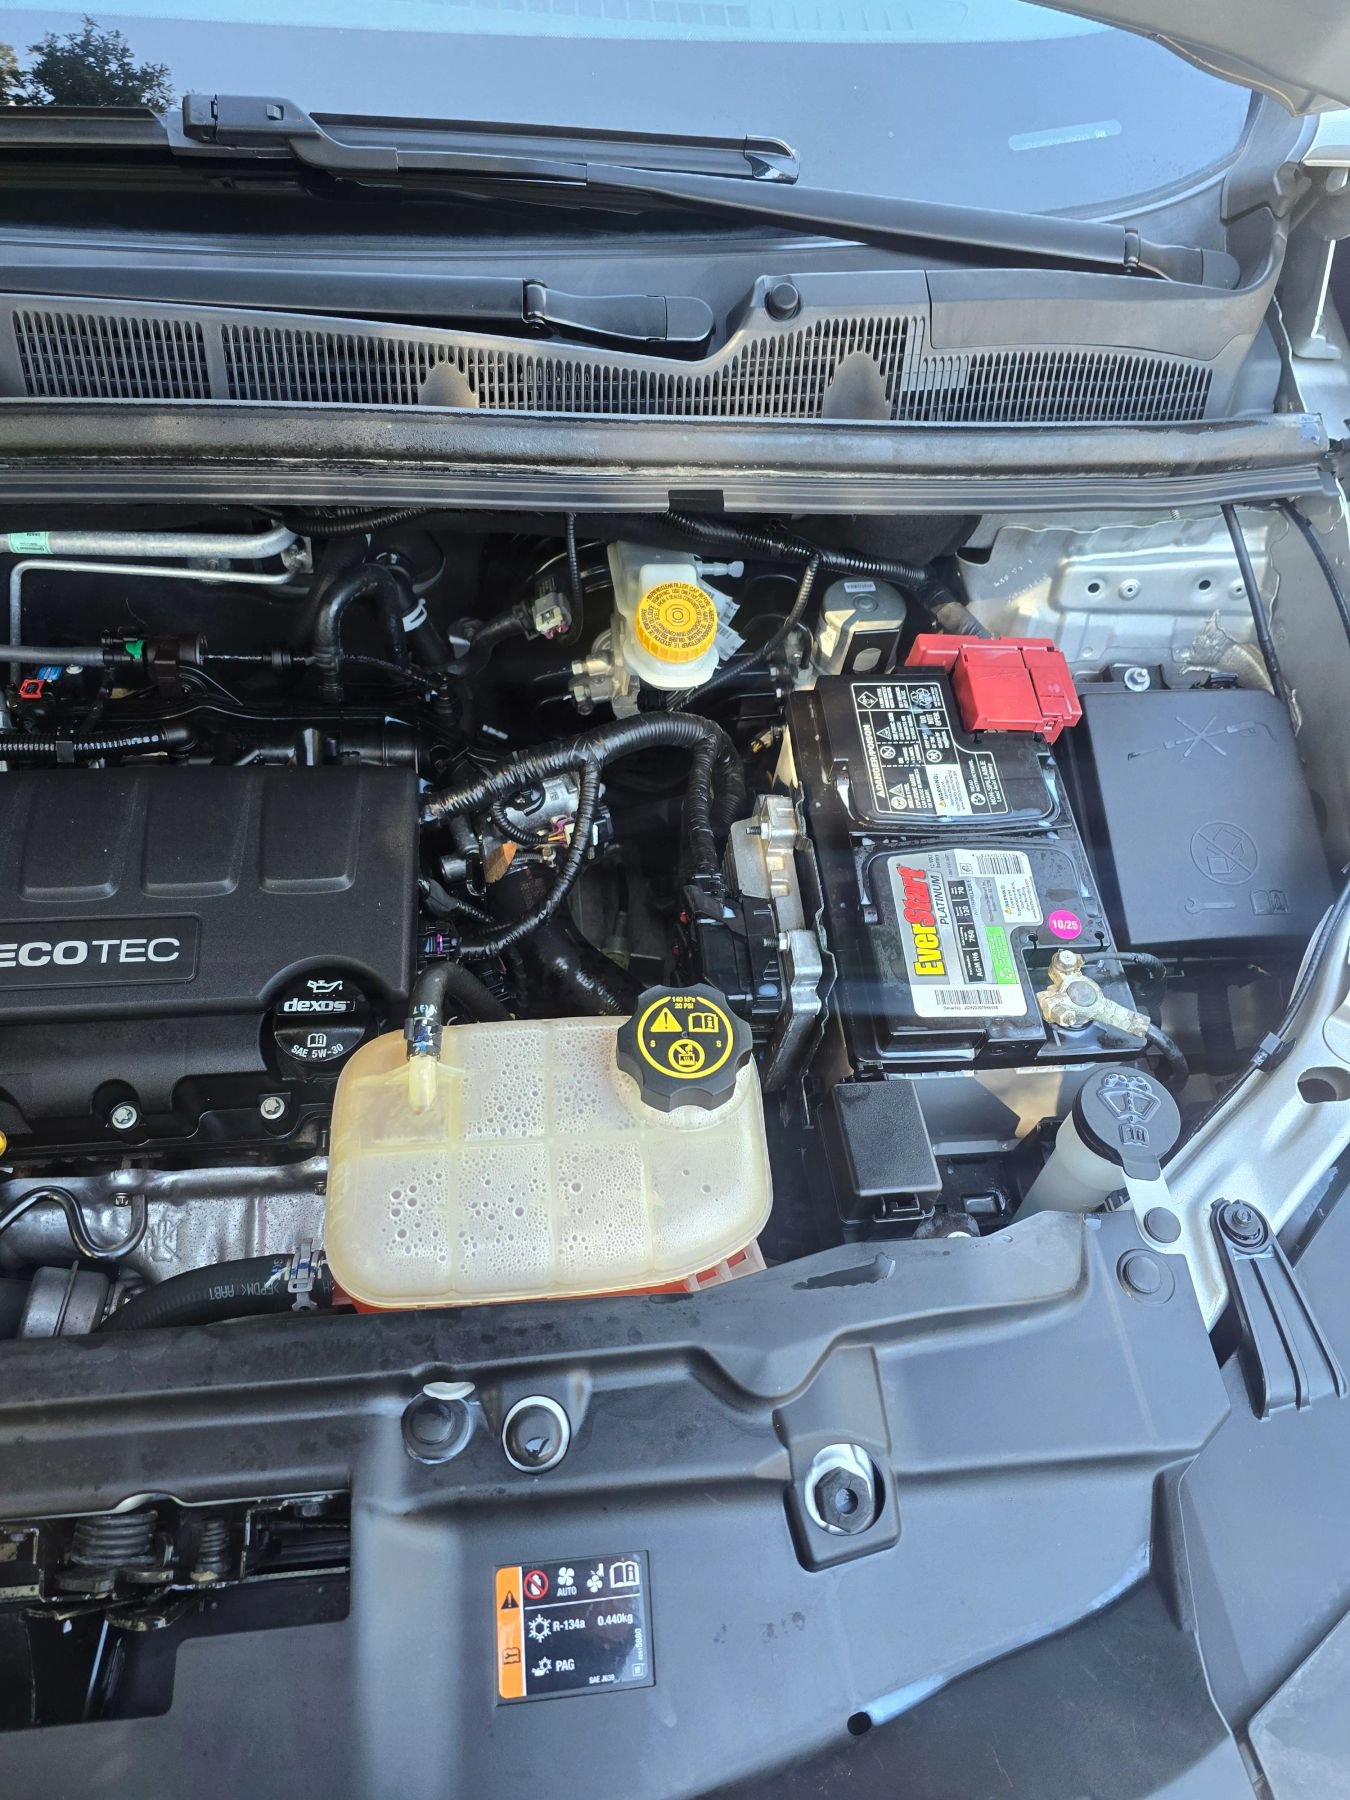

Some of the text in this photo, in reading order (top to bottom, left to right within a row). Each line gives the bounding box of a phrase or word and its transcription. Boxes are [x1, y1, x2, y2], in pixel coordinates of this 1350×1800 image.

[930, 875, 949, 925] PLATINUM
[896, 866, 945, 975] EverStart
[1051, 919, 1078, 931] 10/25
[0, 937, 181, 968] ECOTEC
[972, 952, 983, 977] AGM H6
[284, 998, 346, 1011] dexos
[292, 1044, 343, 1058] SAE 5W-30
[557, 1586, 577, 1597] AUTO
[553, 1614, 633, 1632] R-134a 0.440kg
[555, 1660, 575, 1672] PAG
[589, 1676, 600, 1684] SAE
